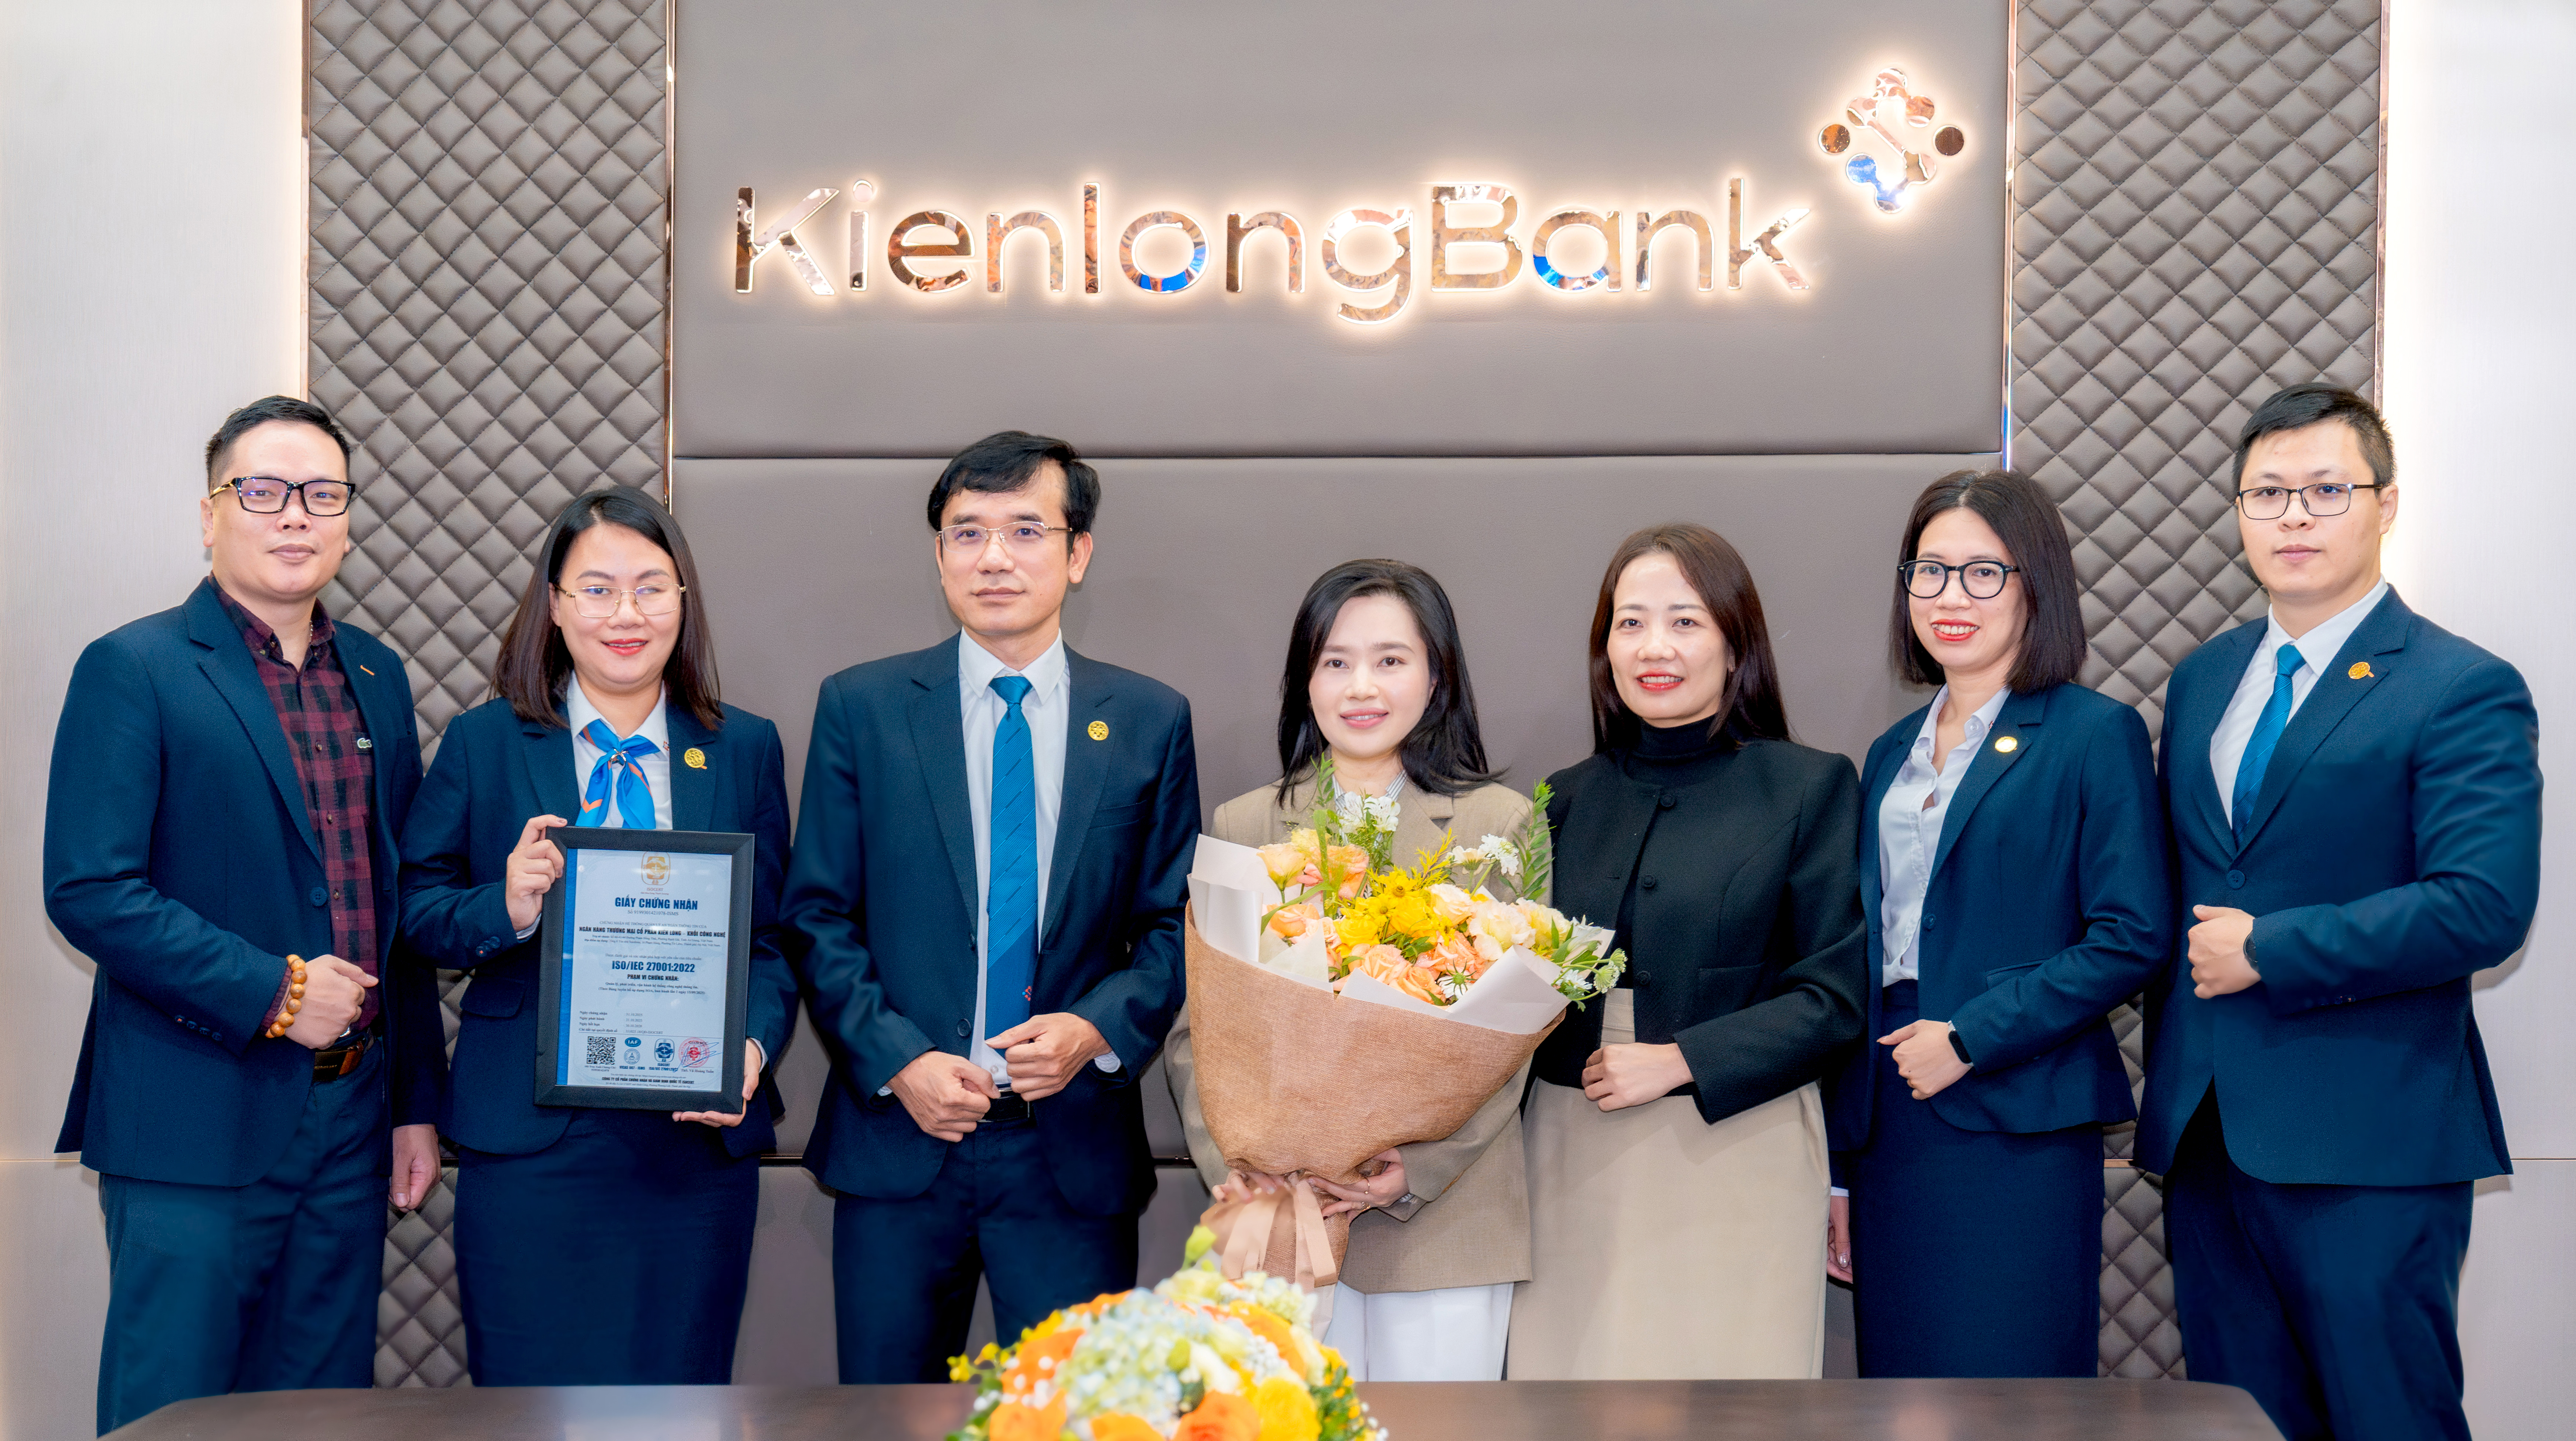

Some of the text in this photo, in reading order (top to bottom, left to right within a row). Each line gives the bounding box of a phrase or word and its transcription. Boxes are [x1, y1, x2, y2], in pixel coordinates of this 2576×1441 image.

[734, 178, 1812, 324] KienlongBank
[615, 894, 697, 911] GIẤY CHỨNG NHẬN
[612, 961, 695, 972] ISO/IEC 27001:2022
